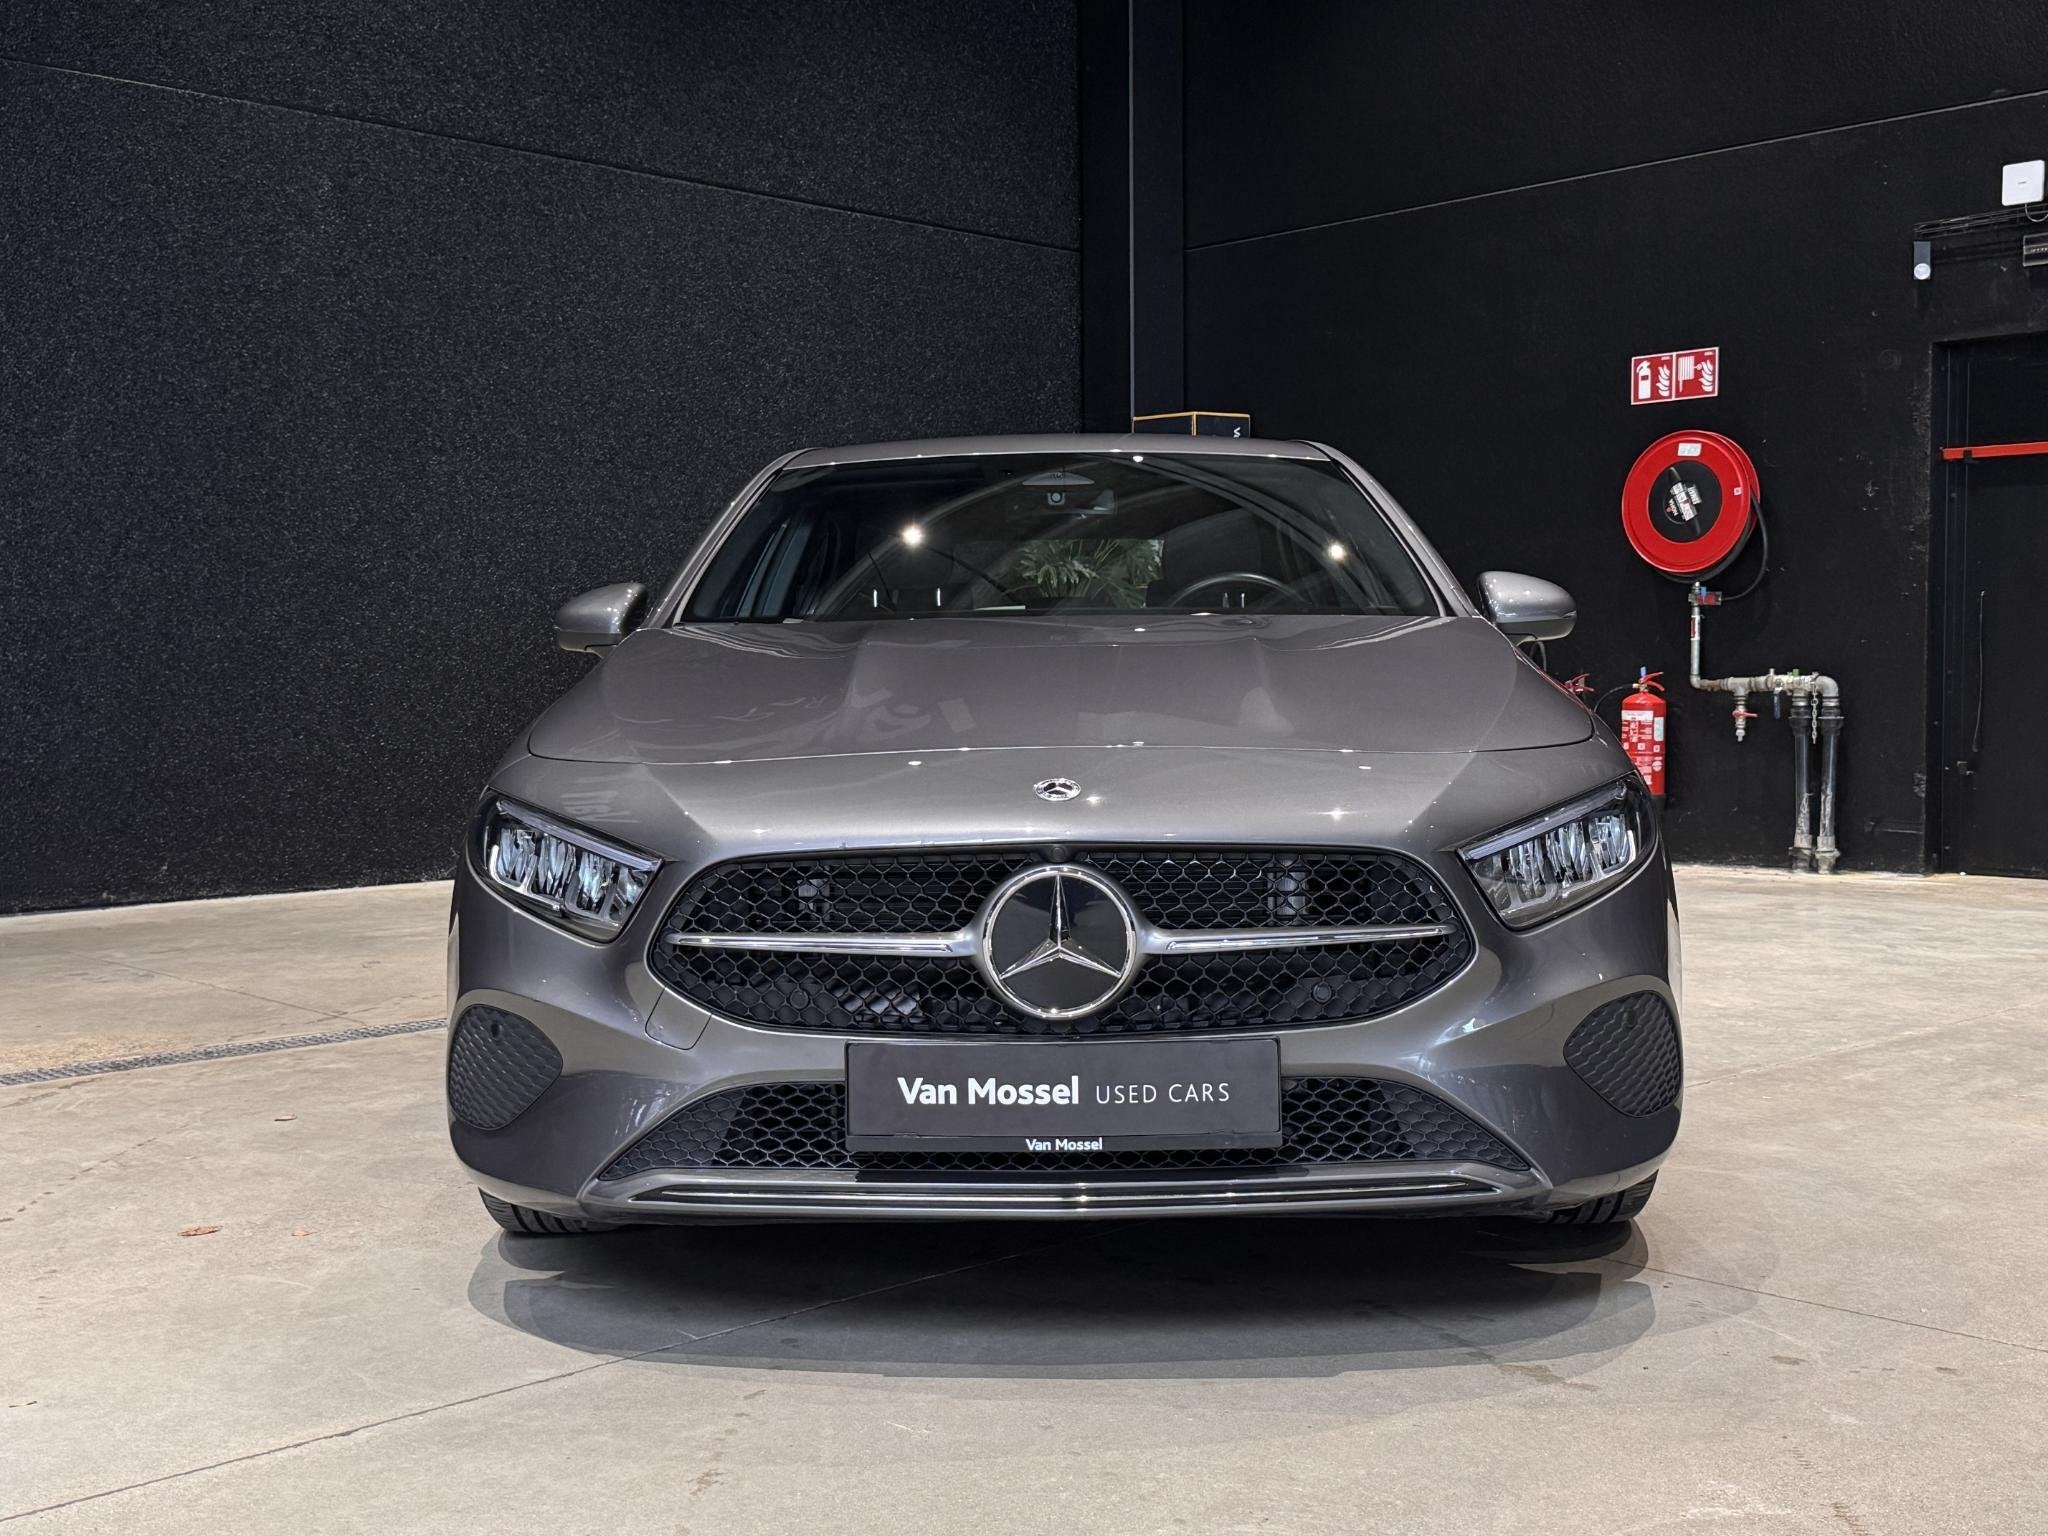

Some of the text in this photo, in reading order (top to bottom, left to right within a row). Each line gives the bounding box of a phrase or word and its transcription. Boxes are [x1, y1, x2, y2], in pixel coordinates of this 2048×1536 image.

[897, 1075, 1231, 1106] Van Mossel USED CARS
[1025, 1136, 1103, 1151] Van Mossel
